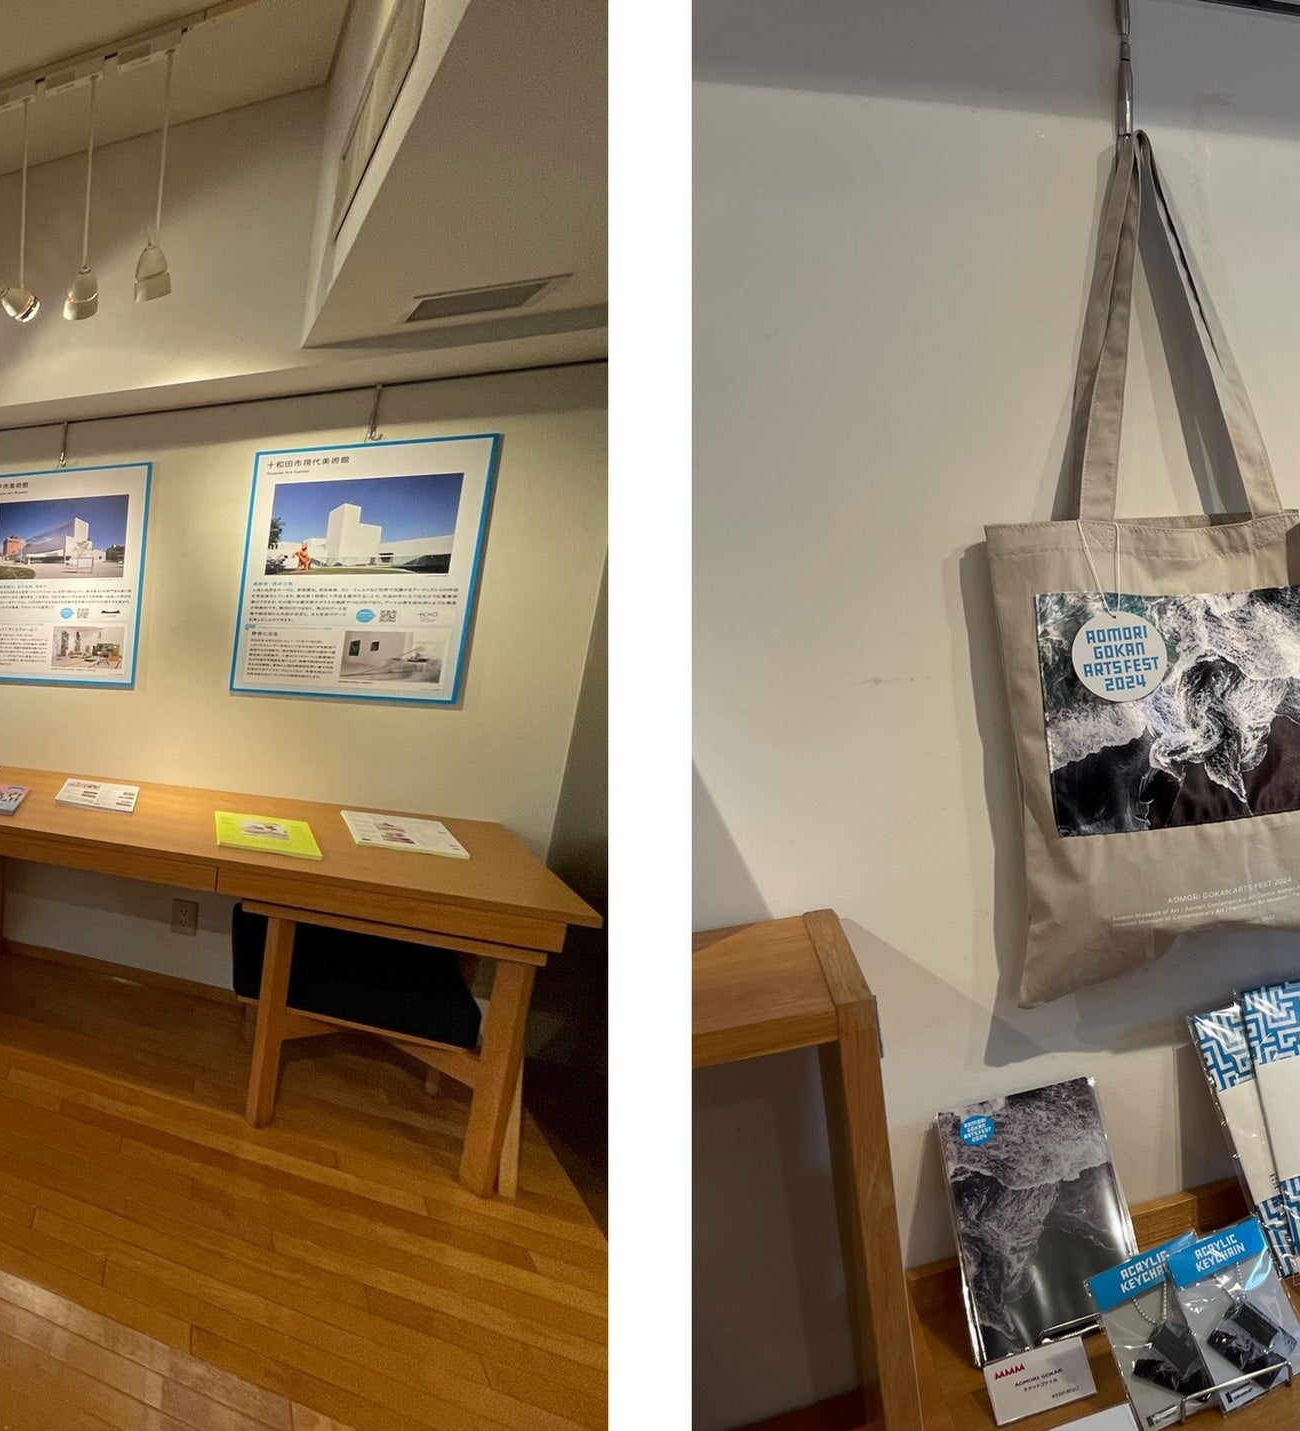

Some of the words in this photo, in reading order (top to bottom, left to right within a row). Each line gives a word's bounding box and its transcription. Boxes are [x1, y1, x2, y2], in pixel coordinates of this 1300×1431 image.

[267, 456, 350, 469] 十和田市現代美術館
[1085, 625, 1148, 644] AOMORI
[1093, 642, 1146, 660] GOKAN
[1104, 674, 1147, 692] 2024
[1167, 893, 1201, 904] AOMORI
[1202, 888, 1231, 899] GOKAN
[1233, 884, 1253, 894] ARTS
[1254, 880, 1272, 889] FEST
[1274, 876, 1292, 886] 2024
[964, 1117, 987, 1129] AOMORI
[966, 1123, 986, 1133] GOKAN
[1194, 1233, 1238, 1261] ACRYLIC
[1195, 1242, 1245, 1273] KEYCHAIN
[1014, 1375, 1040, 1388] AOMORI
[1041, 1368, 1063, 1379] GOKAN
[1023, 1378, 1059, 1393] チケットファイル
